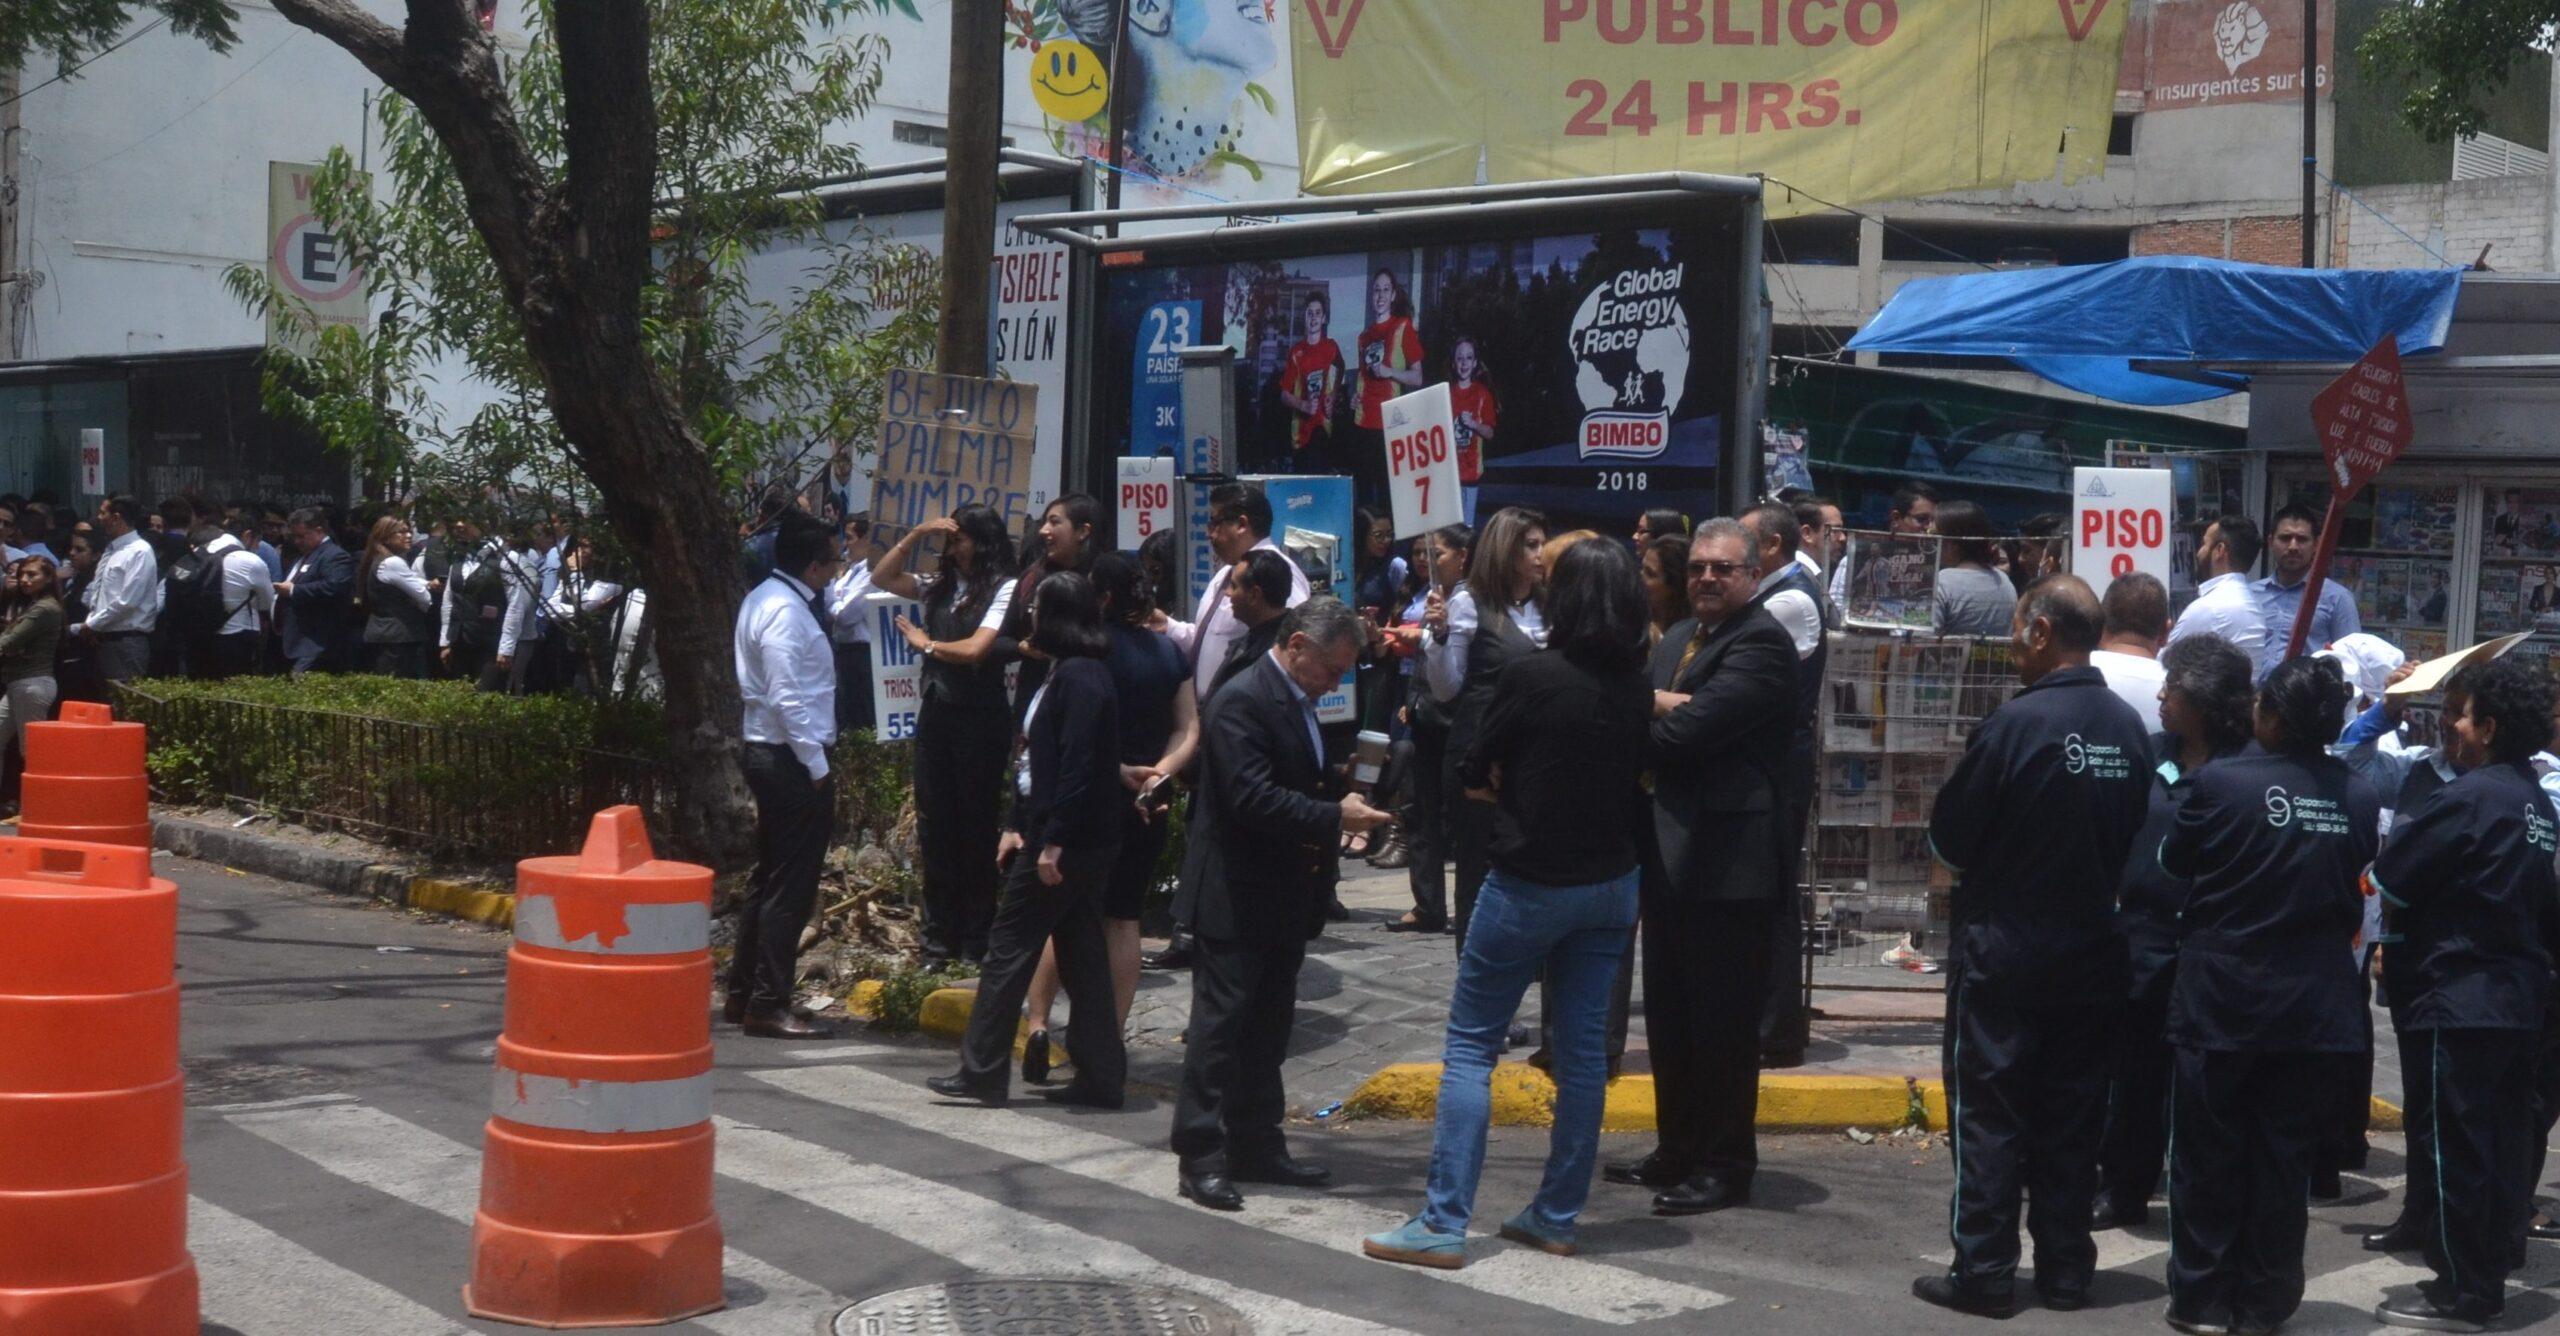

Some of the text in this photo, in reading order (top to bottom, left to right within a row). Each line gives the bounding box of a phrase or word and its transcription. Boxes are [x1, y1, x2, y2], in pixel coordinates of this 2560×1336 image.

[2155, 76, 2260, 102] insurgentes
[2266, 73, 2296, 92] sur
[1564, 78, 1861, 136] 24 HRS.
[302, 232, 337, 282] E
[1614, 262, 1684, 298] Global
[1597, 296, 1676, 327] Energy
[1148, 306, 1190, 355] 23
[1583, 327, 1638, 355] Race
[889, 369, 1020, 431] BEJUCO
[1155, 406, 1175, 428] 3K
[1390, 424, 1447, 476] PISO
[1586, 422, 1662, 447] BIMBO
[880, 420, 1014, 487] PALMA
[1121, 484, 1168, 509] PISO
[1415, 476, 1430, 515] 7
[1597, 471, 1648, 490] 2018
[1138, 511, 1151, 536] 5
[2082, 508, 2163, 548] PISO
[888, 712, 918, 738] 55
